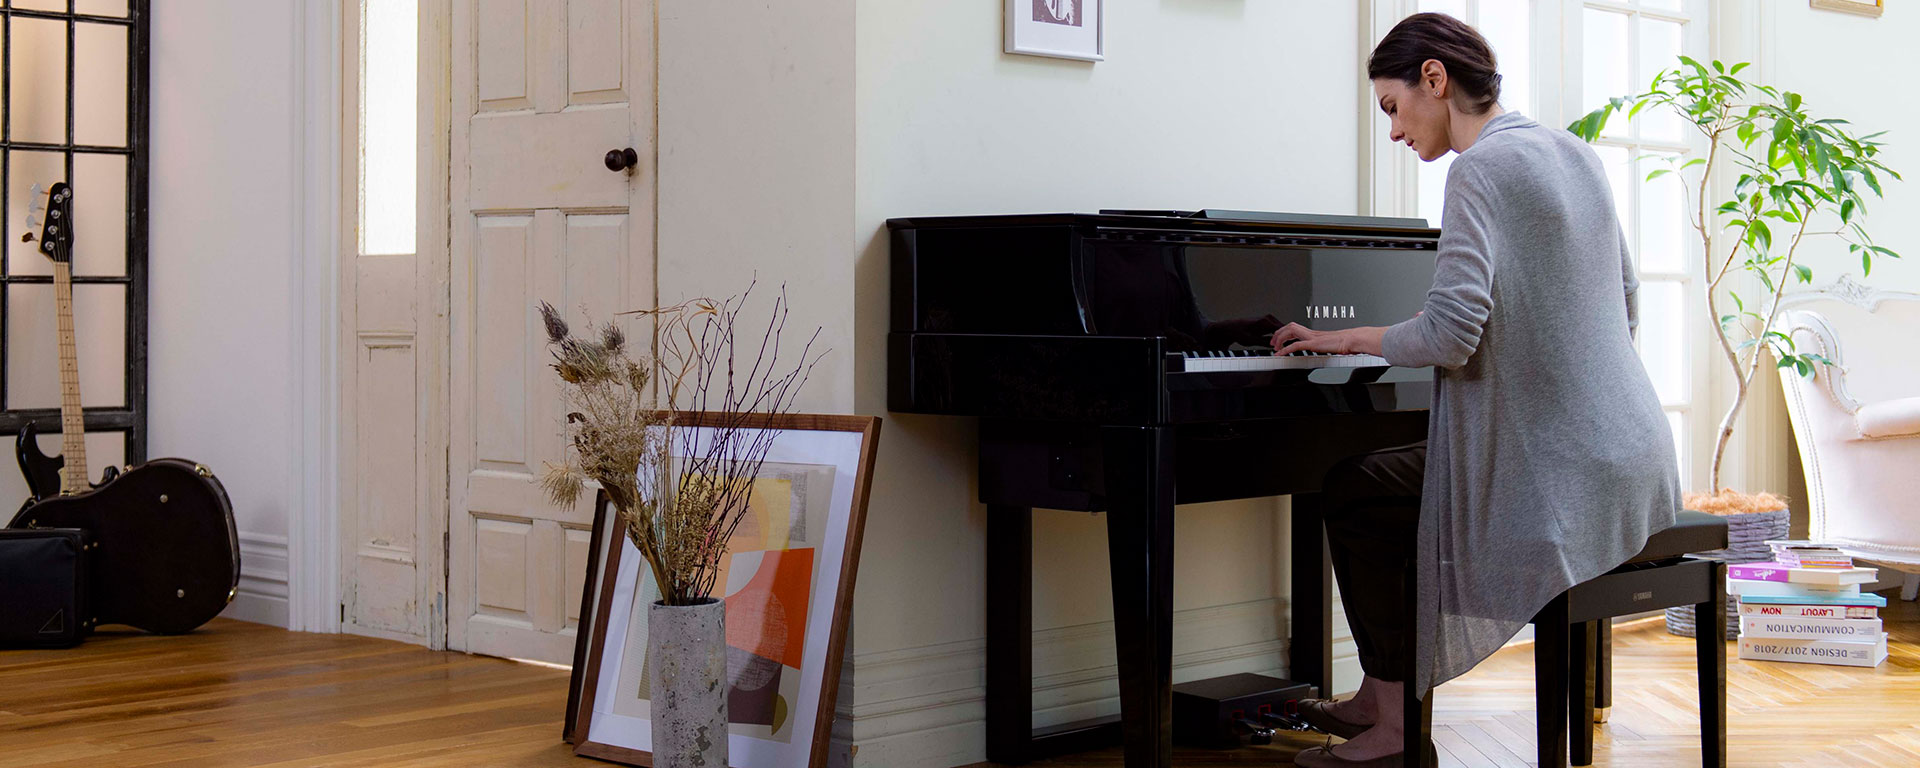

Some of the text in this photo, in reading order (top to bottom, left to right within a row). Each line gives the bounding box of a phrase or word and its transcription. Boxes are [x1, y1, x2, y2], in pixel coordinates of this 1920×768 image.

[1306, 306, 1355, 318] YAMAHA
[1760, 607, 1782, 616] NOW
[1800, 608, 1834, 617] LAYOUT
[1766, 624, 1855, 635] COMMUNICATION
[1754, 645, 1807, 656] 2017/2018
[1811, 647, 1848, 658] DESIGN
